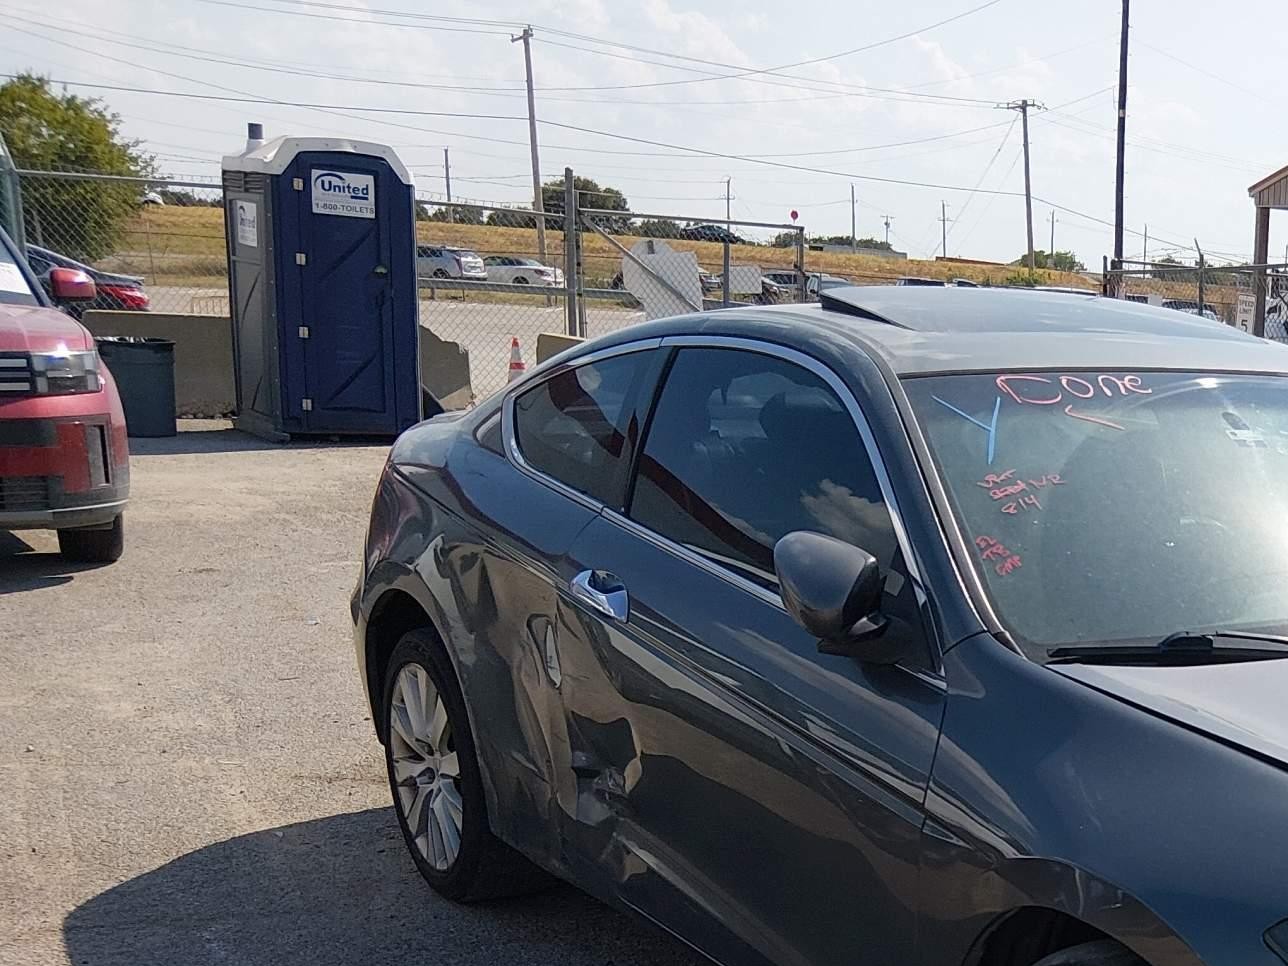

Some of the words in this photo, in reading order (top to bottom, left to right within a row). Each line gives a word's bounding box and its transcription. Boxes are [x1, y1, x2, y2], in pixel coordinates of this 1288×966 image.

[321, 179, 369, 195] United
[315, 202, 375, 214] 1-800-TOILETS
[1240, 319, 1248, 332] 5
